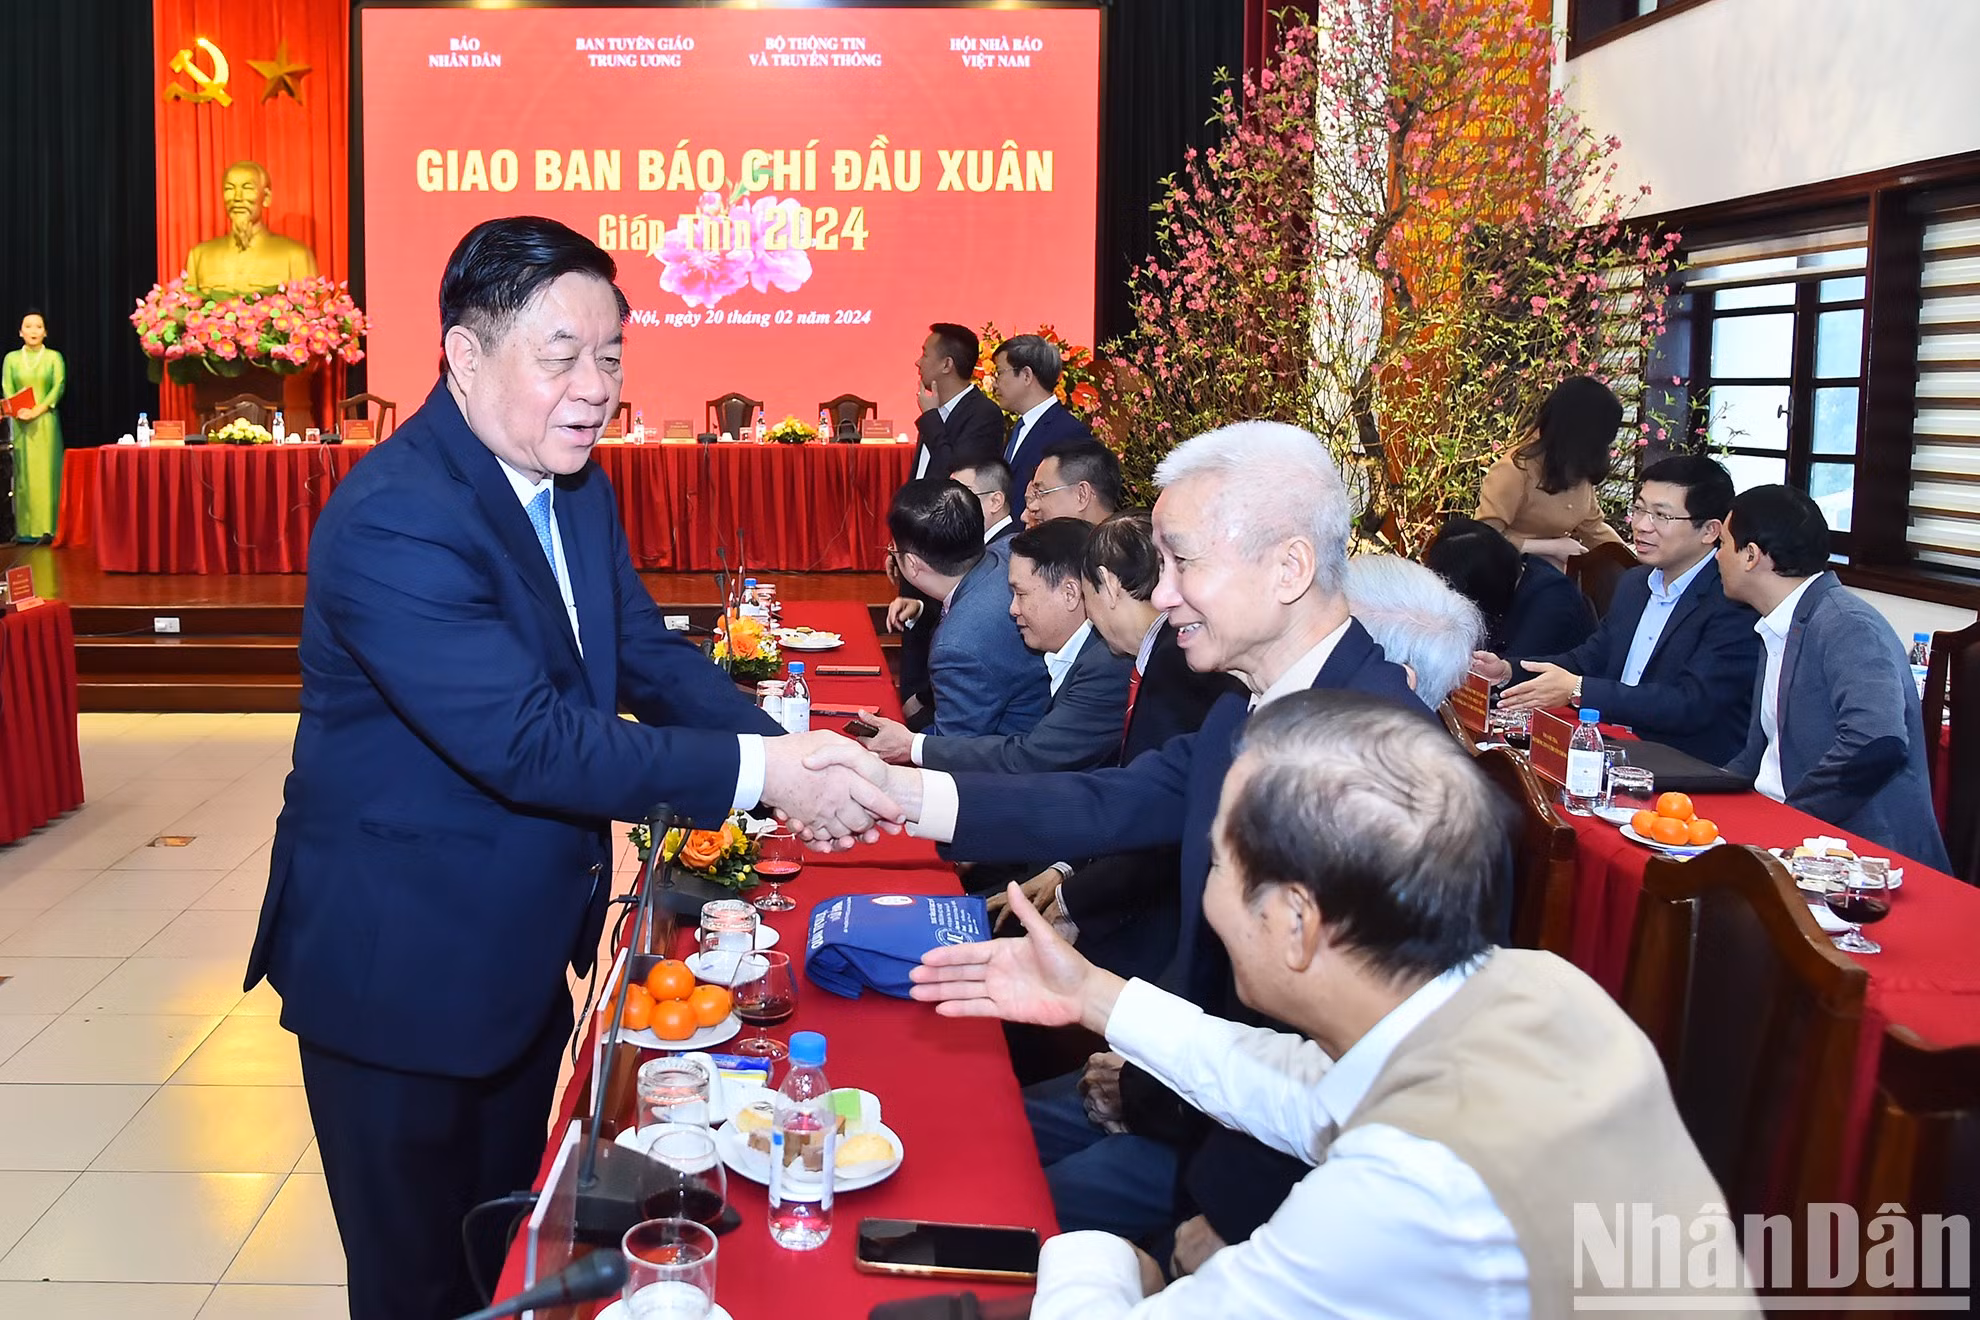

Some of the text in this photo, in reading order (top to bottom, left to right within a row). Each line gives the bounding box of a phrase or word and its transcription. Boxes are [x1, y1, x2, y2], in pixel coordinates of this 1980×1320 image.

[450, 35, 480, 51] BÁO
[576, 34, 695, 51] BAN TUYÊN GIÁO
[766, 35, 866, 51] BỘ THÔNG TIN
[950, 35, 1043, 52] HỘI NHÀ BÁO
[428, 52, 501, 68] NHÂN DÂN
[588, 53, 637, 68] TRUNG
[749, 50, 882, 67] VÀ TRUYỀN THÔNG
[962, 54, 1030, 69] VIỆT NAM
[416, 134, 1053, 192] GIAO BAN BÁO CHÍ ĐẦU XUÂN
[599, 213, 666, 258] Giáp
[764, 206, 869, 251] 2024
[664, 311, 702, 328] ngày
[704, 310, 725, 325] 20
[727, 309, 771, 328] tháng
[774, 310, 793, 325] 02
[796, 310, 831, 325] năm
[834, 310, 873, 325] 2024
